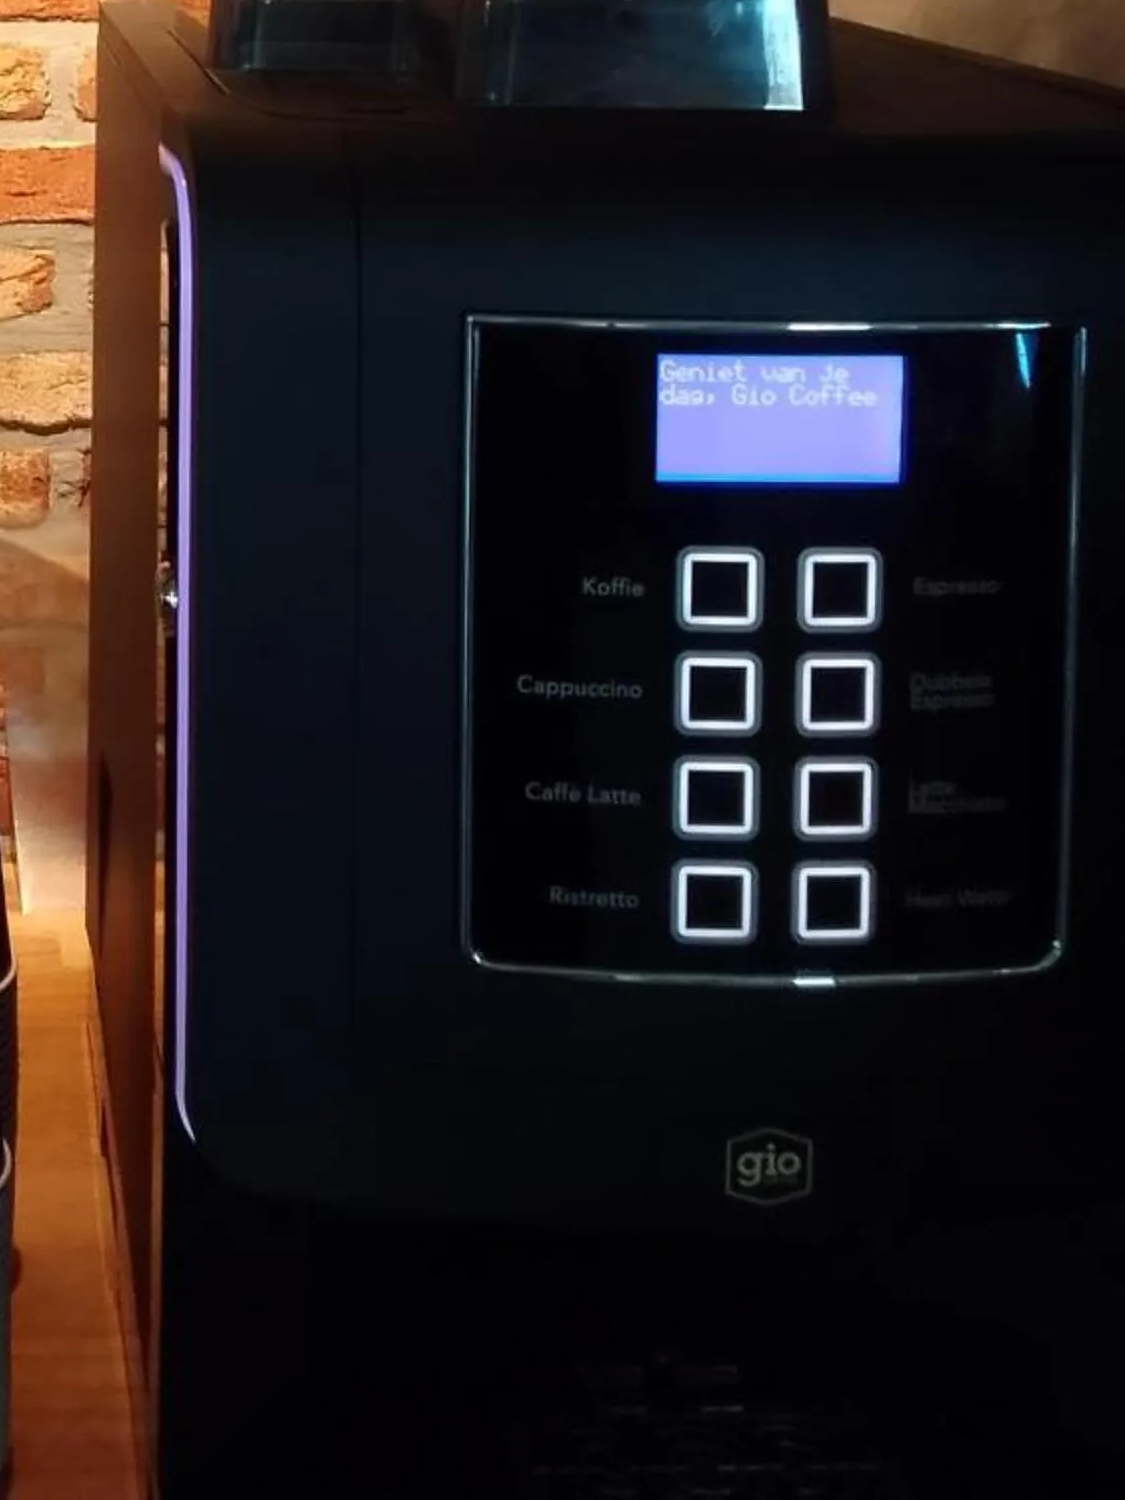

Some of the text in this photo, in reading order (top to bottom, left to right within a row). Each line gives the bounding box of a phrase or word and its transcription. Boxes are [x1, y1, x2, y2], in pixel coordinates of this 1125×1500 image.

[659, 359, 748, 383] Geniet
[820, 364, 851, 385] je
[731, 384, 777, 406] Gio
[788, 384, 878, 407] Coffee
[580, 575, 646, 599] Koffie
[515, 674, 644, 702] Cappuccino
[586, 782, 644, 806] Latte
[548, 884, 642, 910] Ristretto
[736, 1141, 803, 1188] gio
